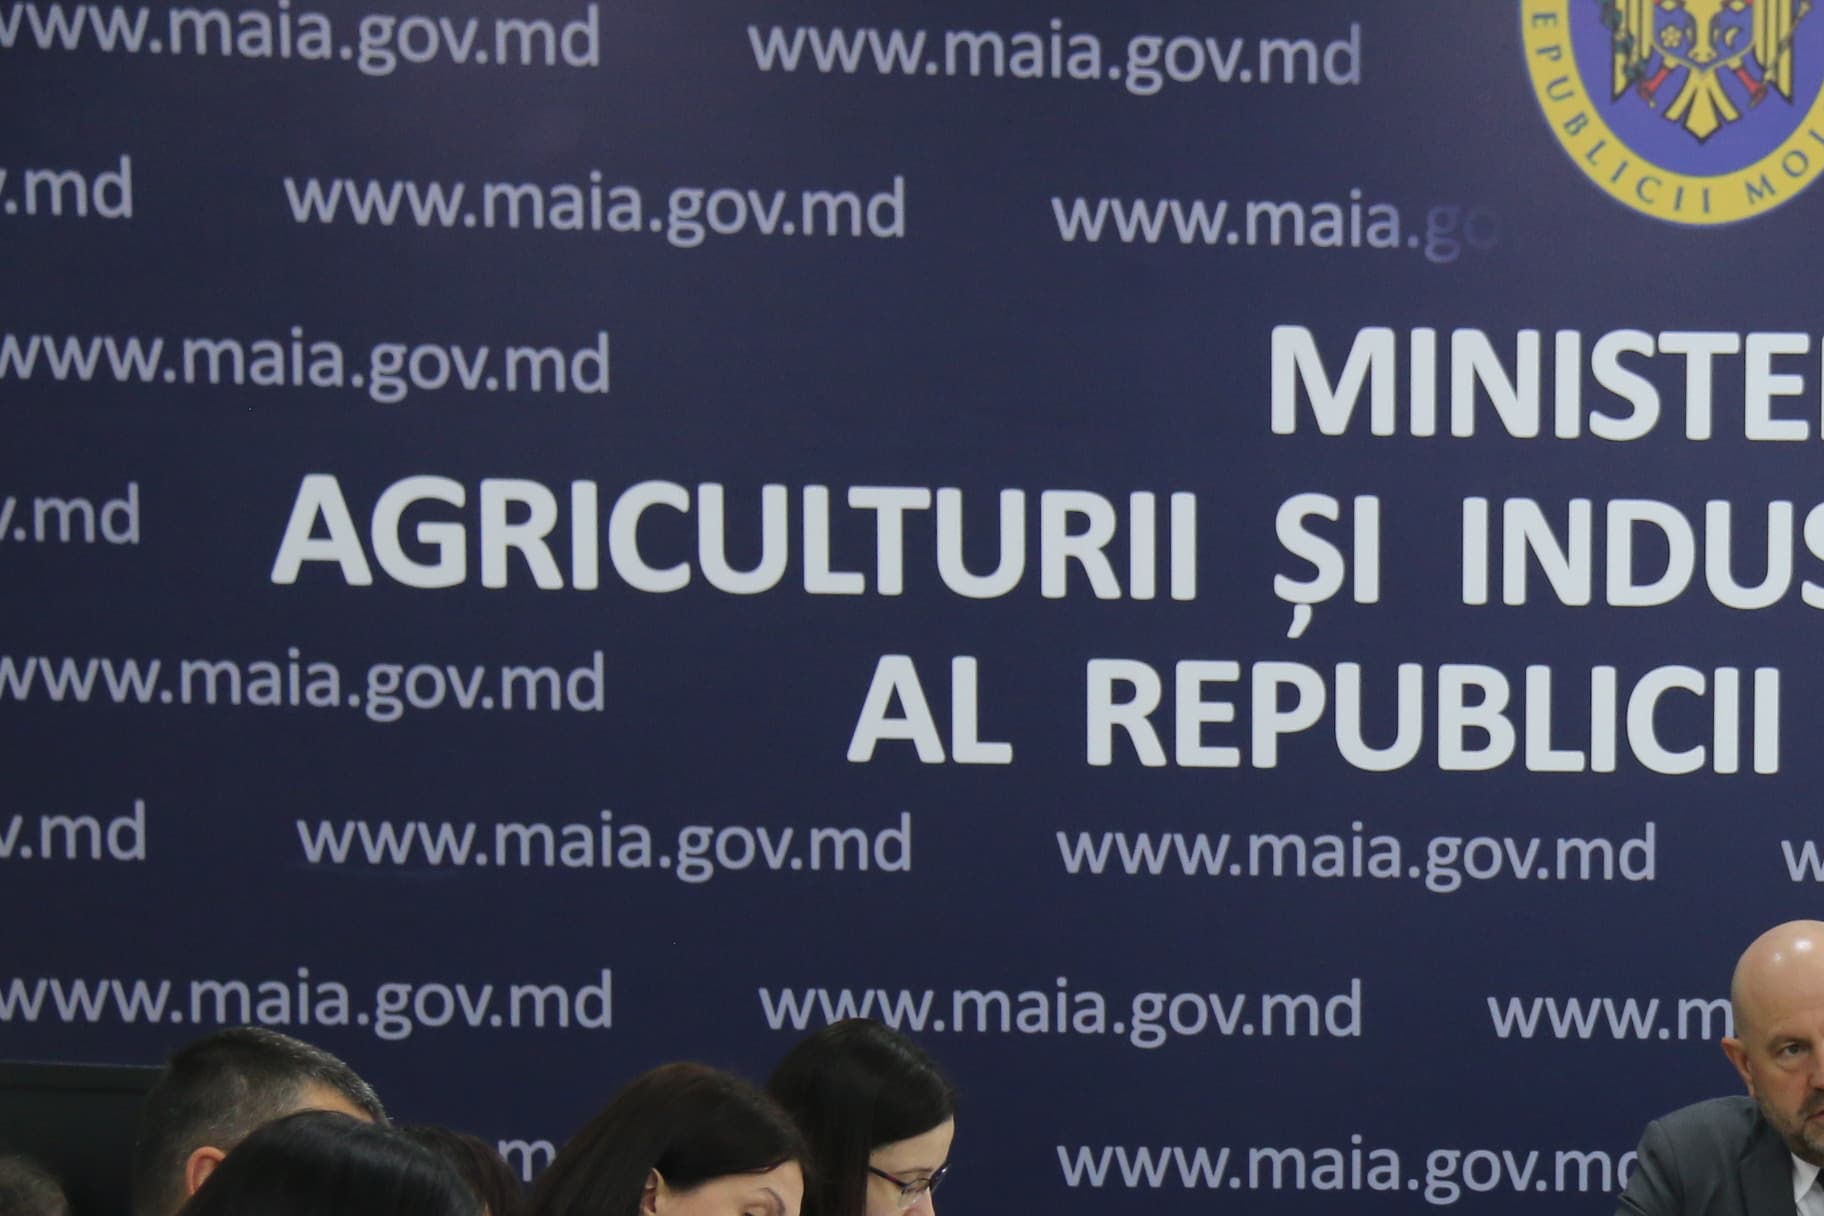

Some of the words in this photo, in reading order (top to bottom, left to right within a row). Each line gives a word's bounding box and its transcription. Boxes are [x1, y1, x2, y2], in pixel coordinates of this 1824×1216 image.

[747, 18, 1361, 96] www.maia.gov.md
[283, 170, 905, 249] www.maia.gov.md
[270, 473, 1197, 601] AGRICULTURII
[1273, 492, 1380, 639] ȘI
[846, 654, 1013, 765] AL
[1086, 658, 1780, 775] REPUBLICII
[296, 809, 911, 884] www.maia.gov.md
[1055, 820, 1656, 893] www.maia.gov.md
[758, 976, 1362, 1049] www.maia.gov.md
